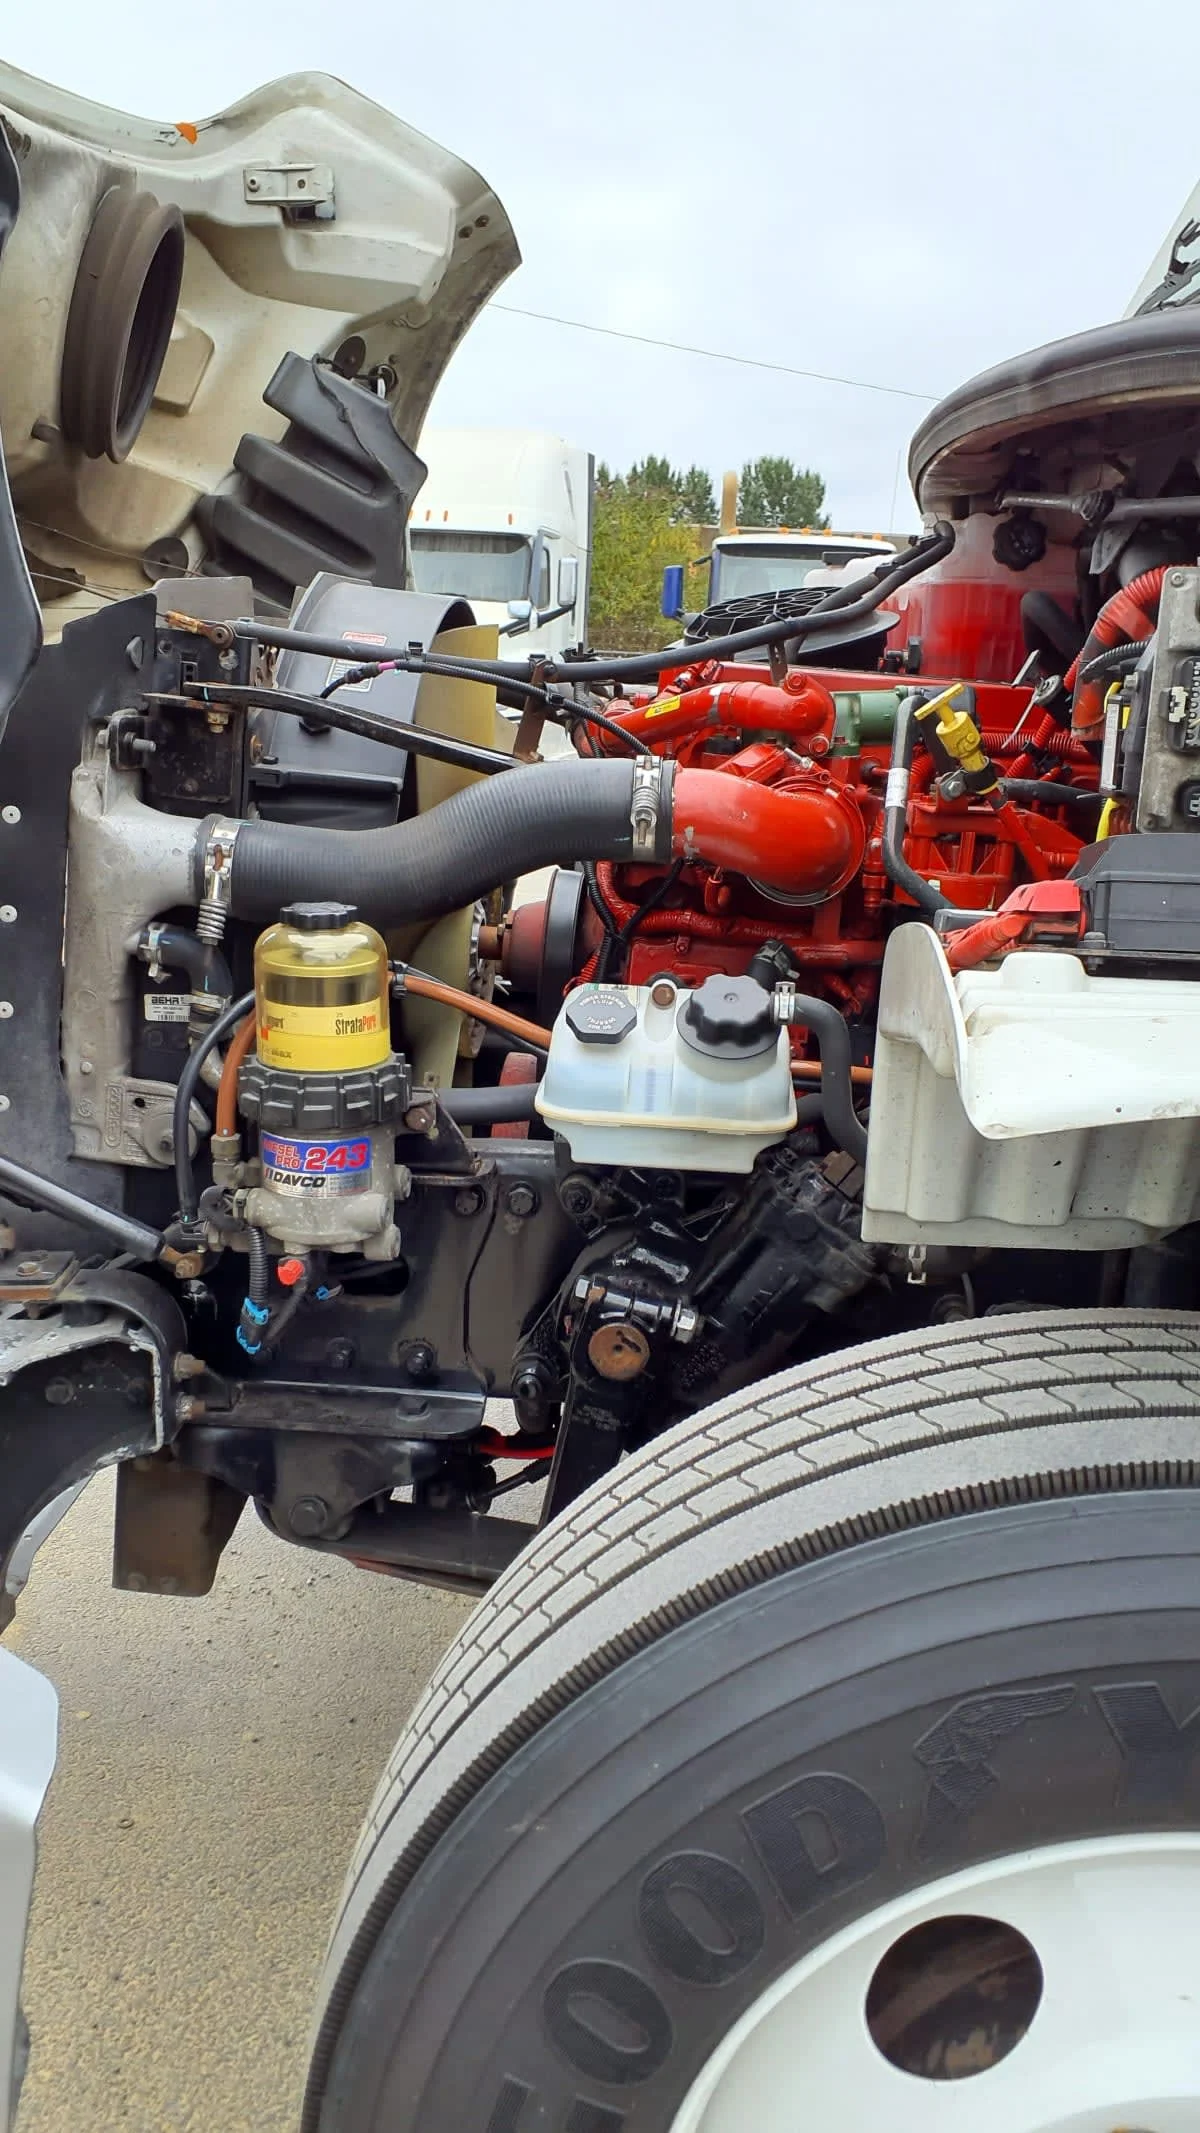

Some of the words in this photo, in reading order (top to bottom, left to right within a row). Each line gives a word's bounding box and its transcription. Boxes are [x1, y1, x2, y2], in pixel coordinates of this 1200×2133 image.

[276, 1154, 302, 1170] PRO
[303, 1143, 369, 1172] 243
[273, 1171, 327, 1189] DAVCO
